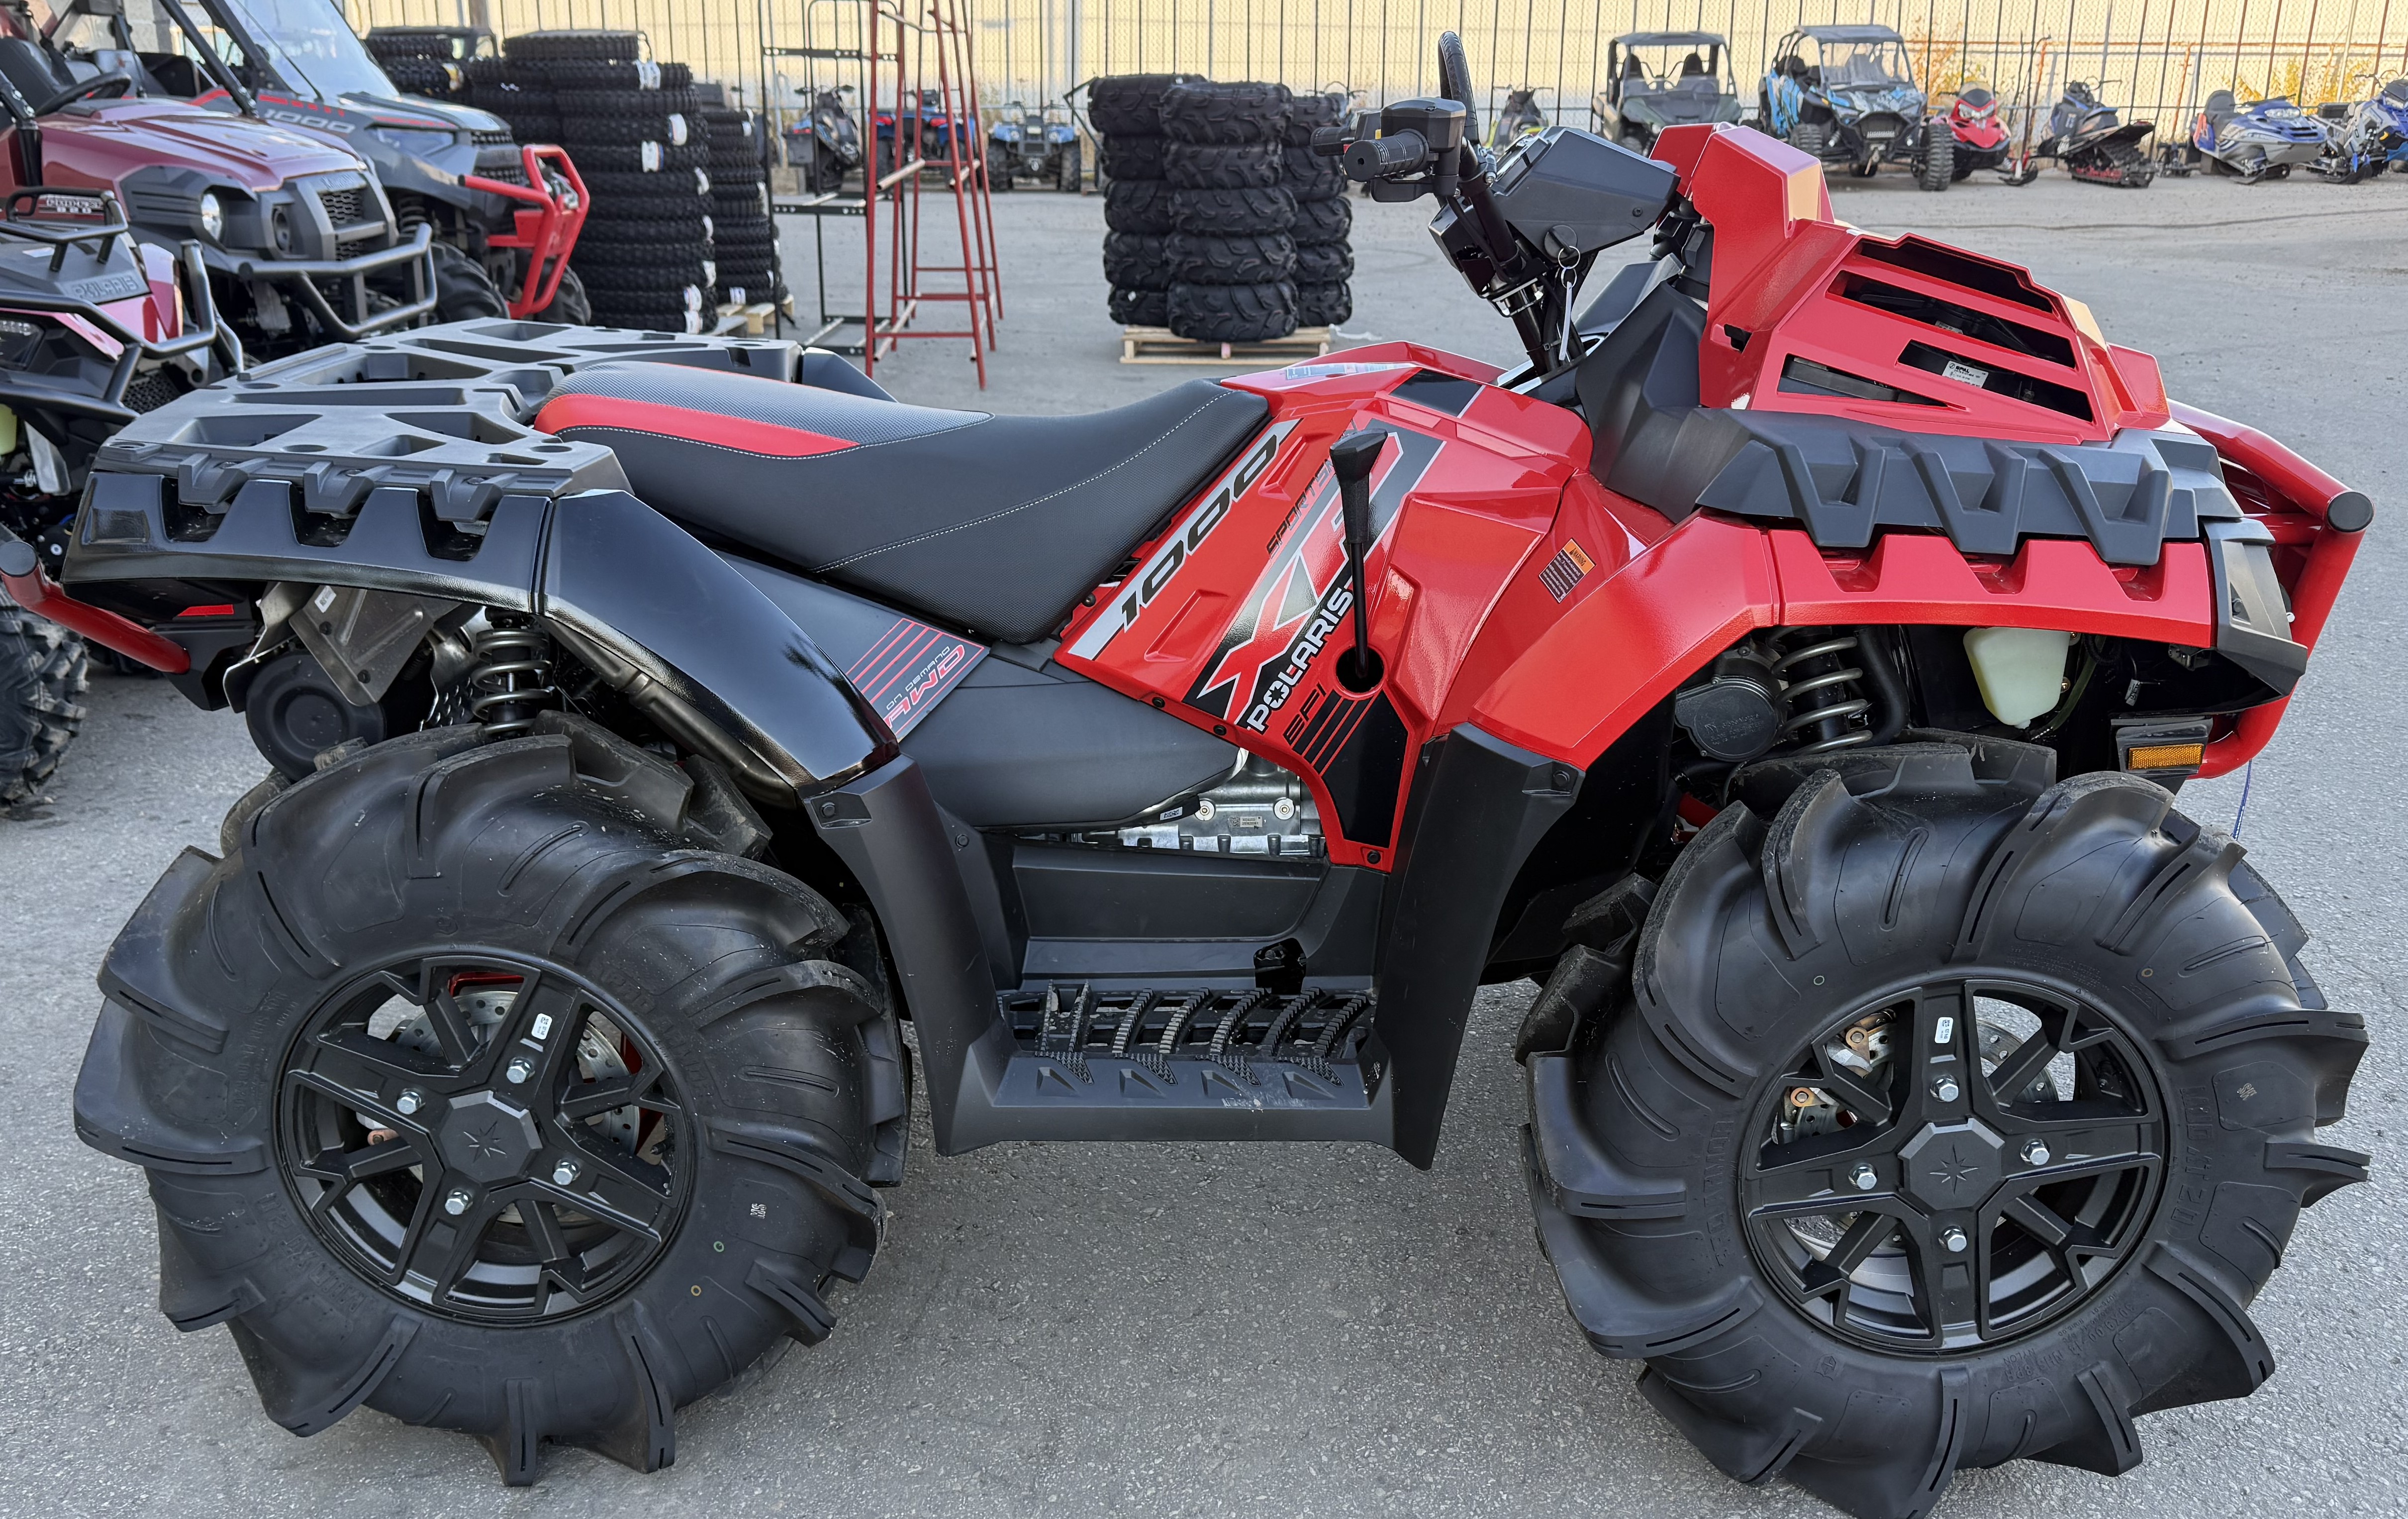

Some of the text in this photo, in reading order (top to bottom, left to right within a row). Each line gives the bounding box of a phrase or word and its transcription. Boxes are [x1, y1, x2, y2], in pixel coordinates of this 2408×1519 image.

[265, 108, 356, 134] 1000
[1120, 434, 1277, 623] 1000
[882, 644, 965, 728] AWD
[1247, 587, 1354, 732] POLARIS
[1282, 682, 1327, 747] EFI
